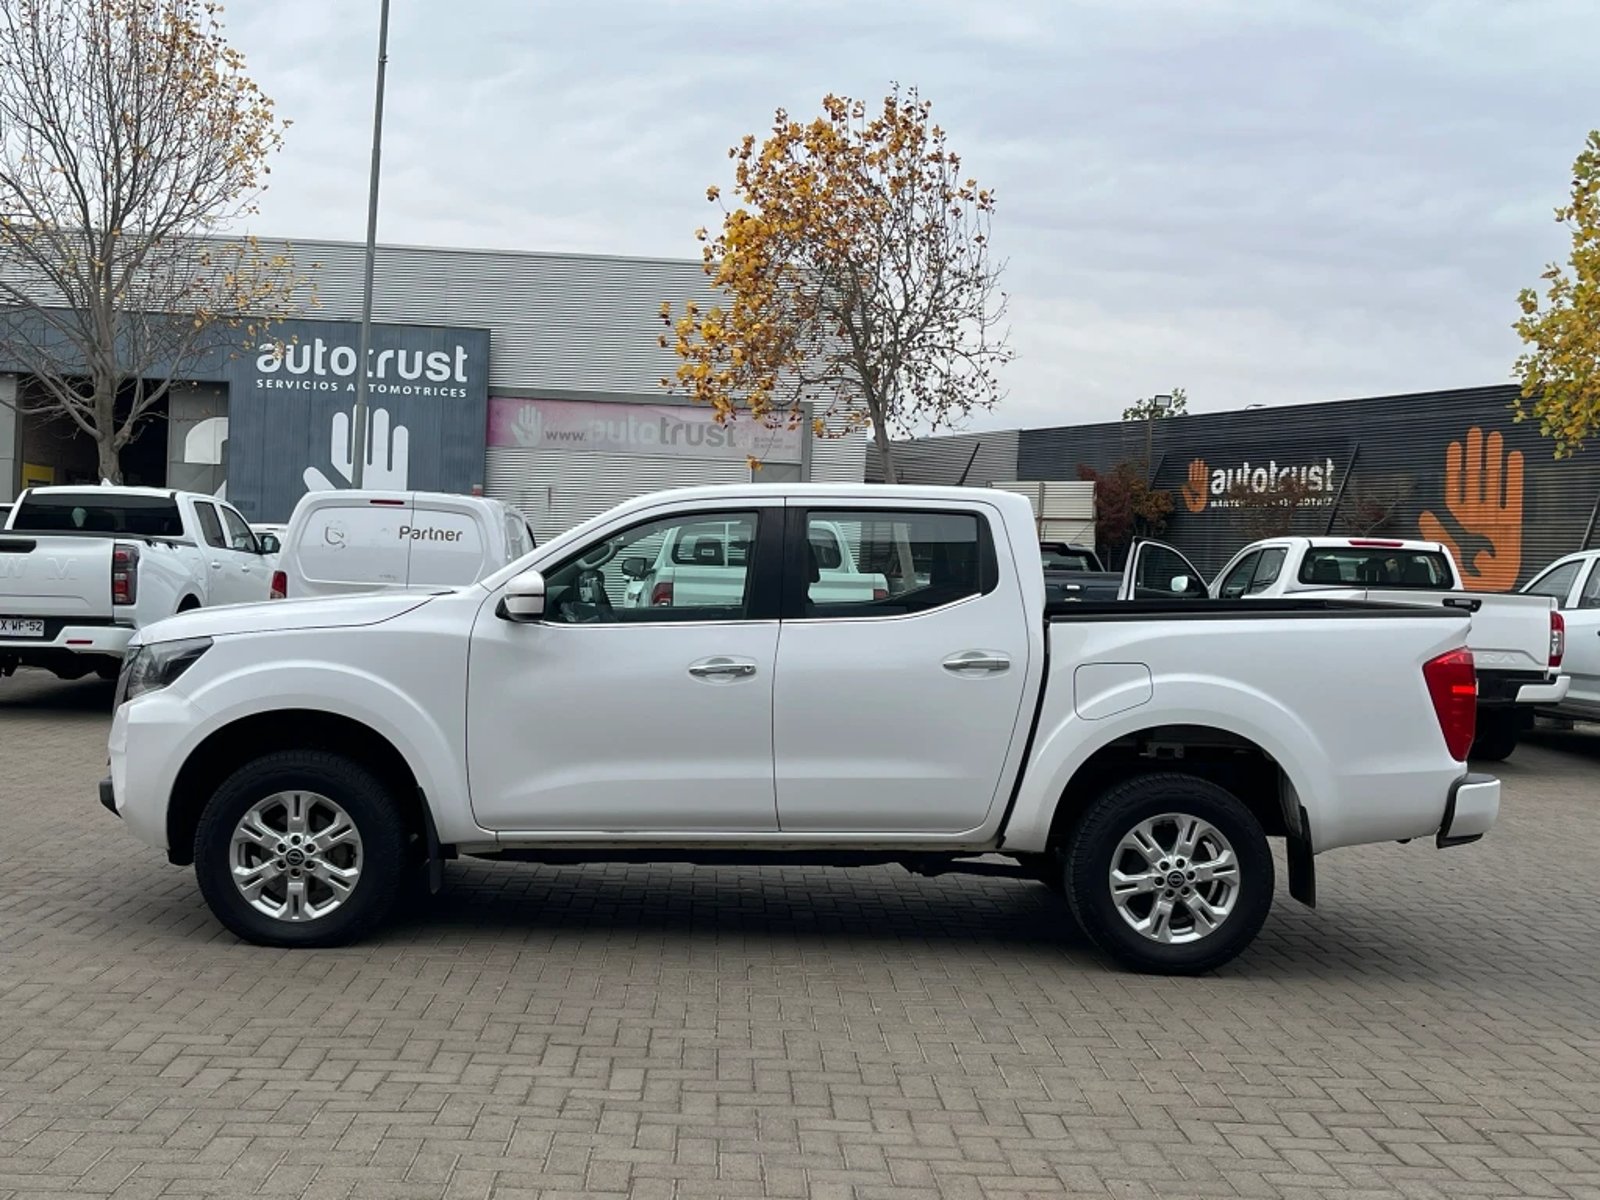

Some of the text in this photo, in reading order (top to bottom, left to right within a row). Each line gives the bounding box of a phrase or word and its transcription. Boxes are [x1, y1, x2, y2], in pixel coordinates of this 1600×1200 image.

[256, 379, 467, 398] SERVICIOS ATOMOTRICES
[399, 525, 463, 542] Partner
